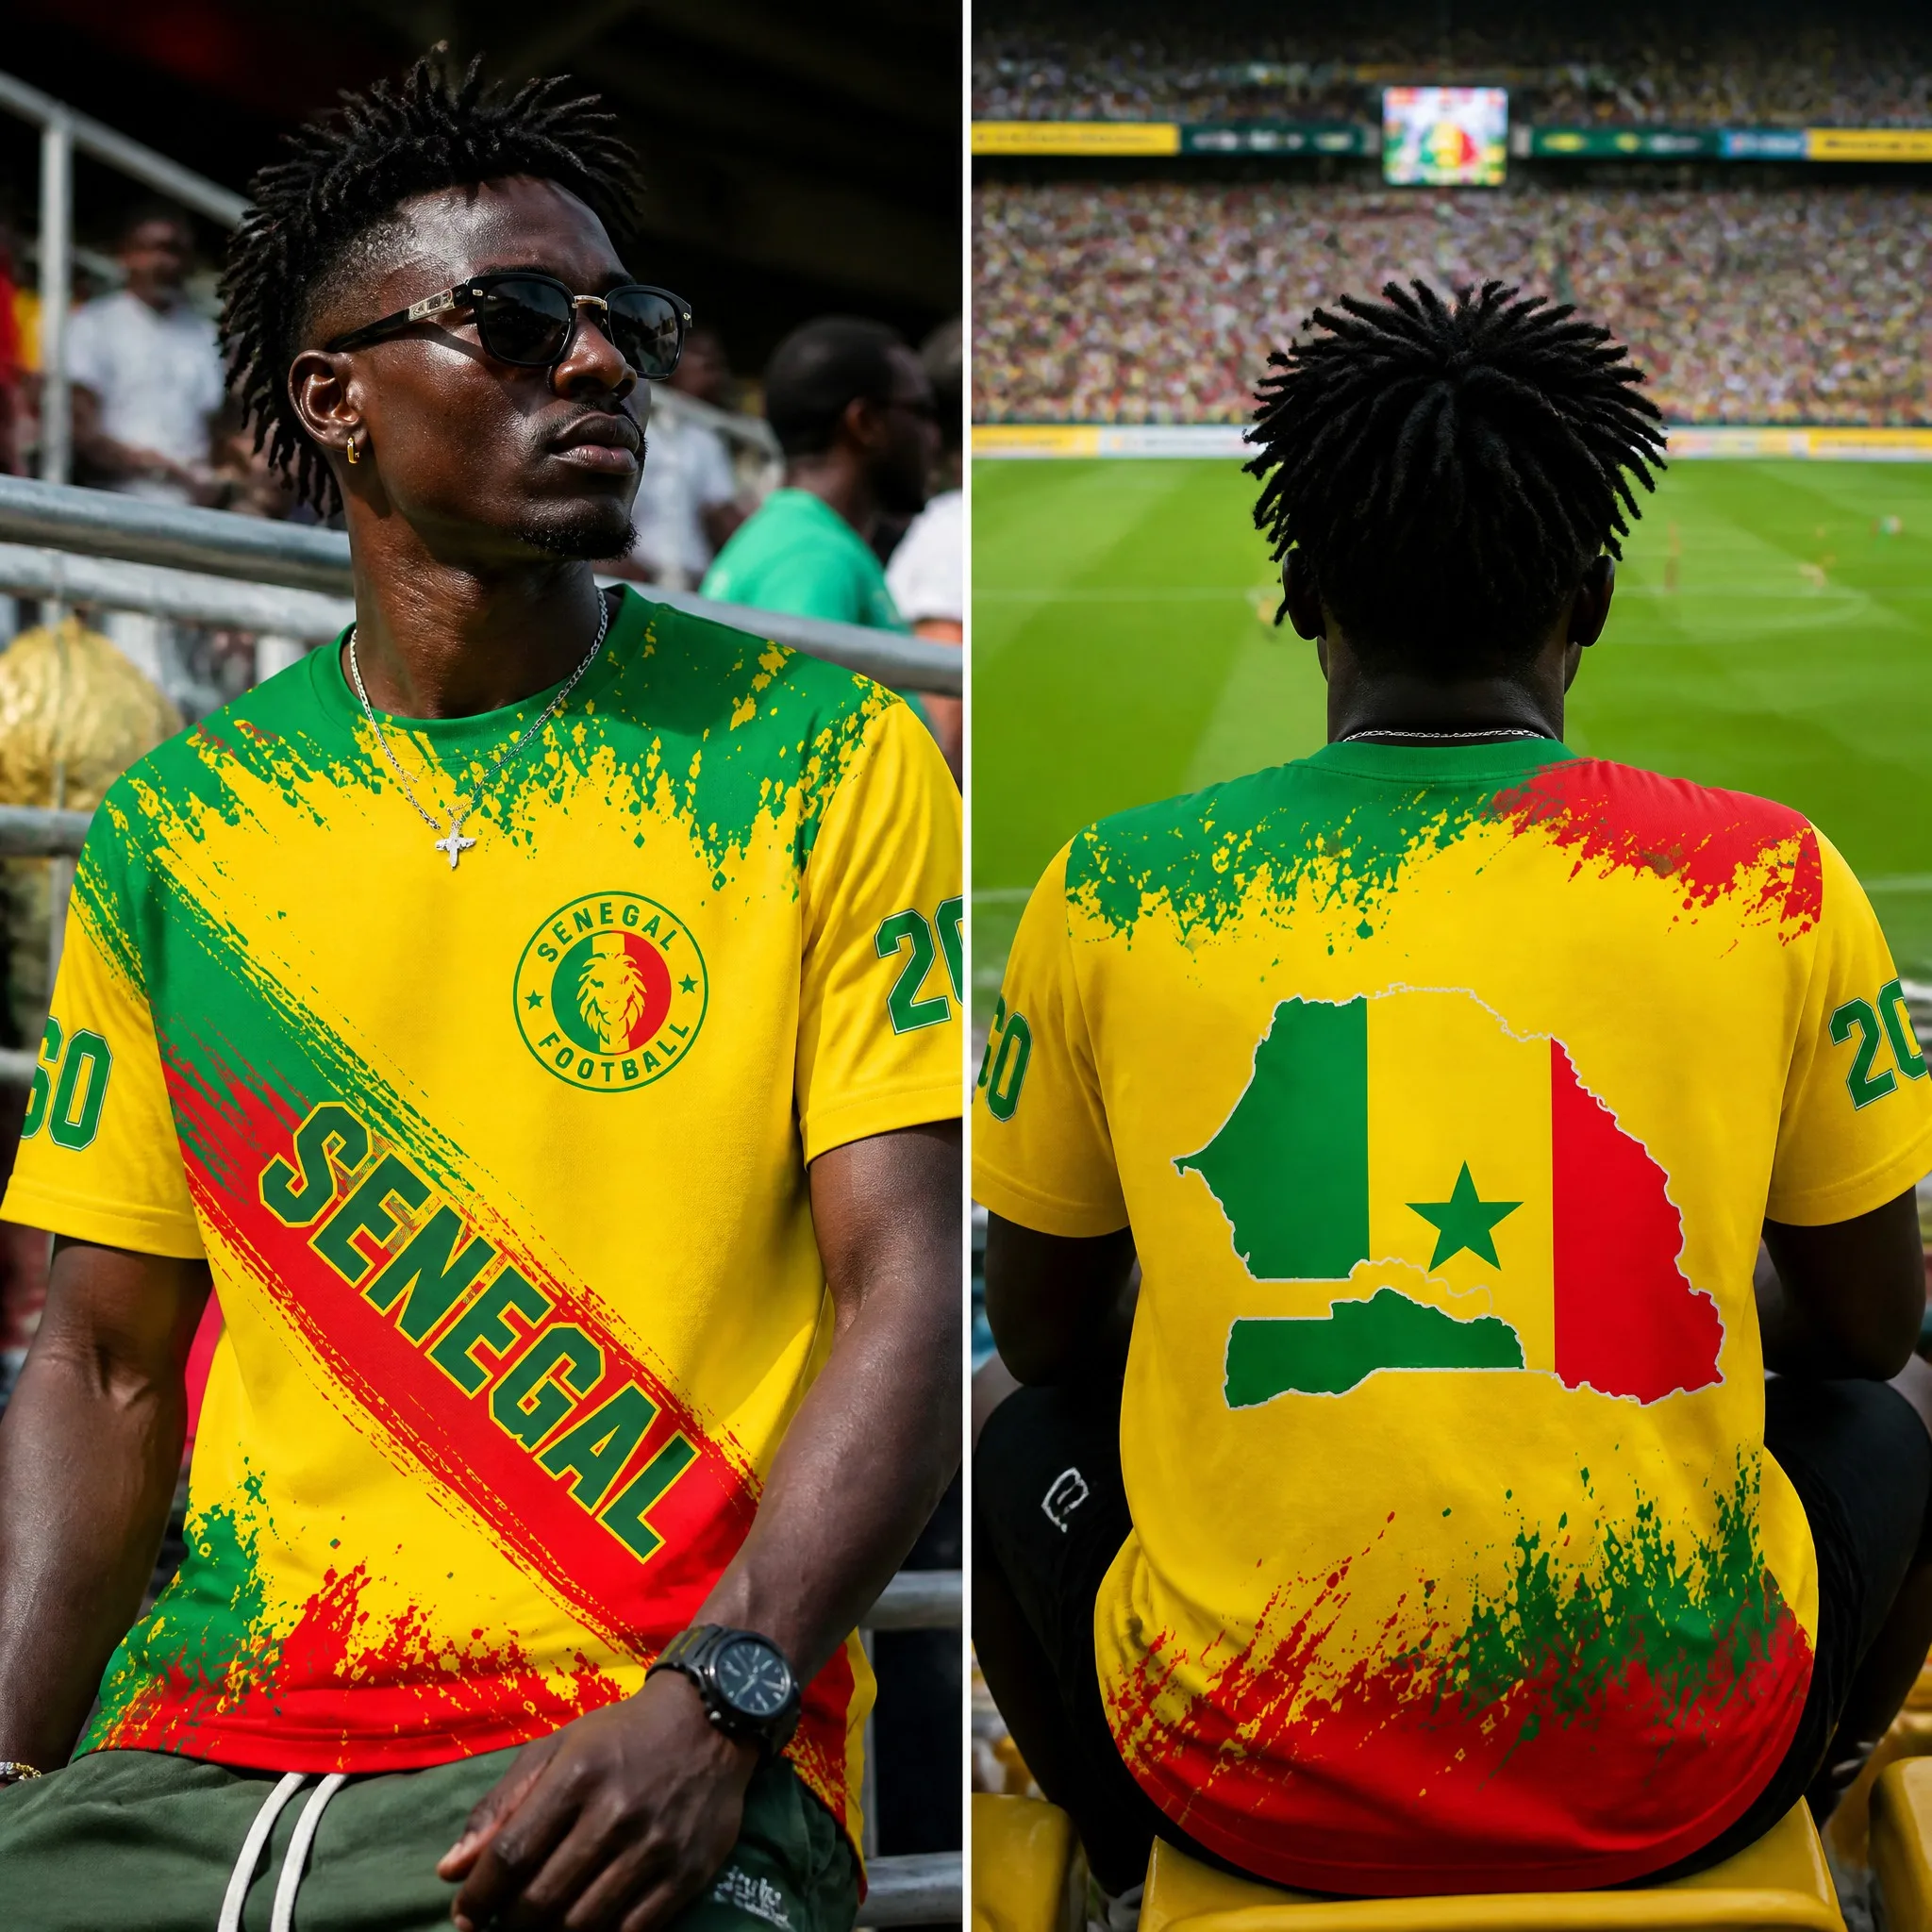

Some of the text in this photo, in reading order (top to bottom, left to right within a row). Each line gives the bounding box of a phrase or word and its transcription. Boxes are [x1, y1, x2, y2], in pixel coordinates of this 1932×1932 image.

[537, 902, 677, 962] SENEGAL
[538, 1024, 690, 1082] FOOTBALL
[978, 993, 1033, 1123] 0
[1828, 977, 1928, 1111] 20
[258, 1102, 702, 1564] SENEGAL
